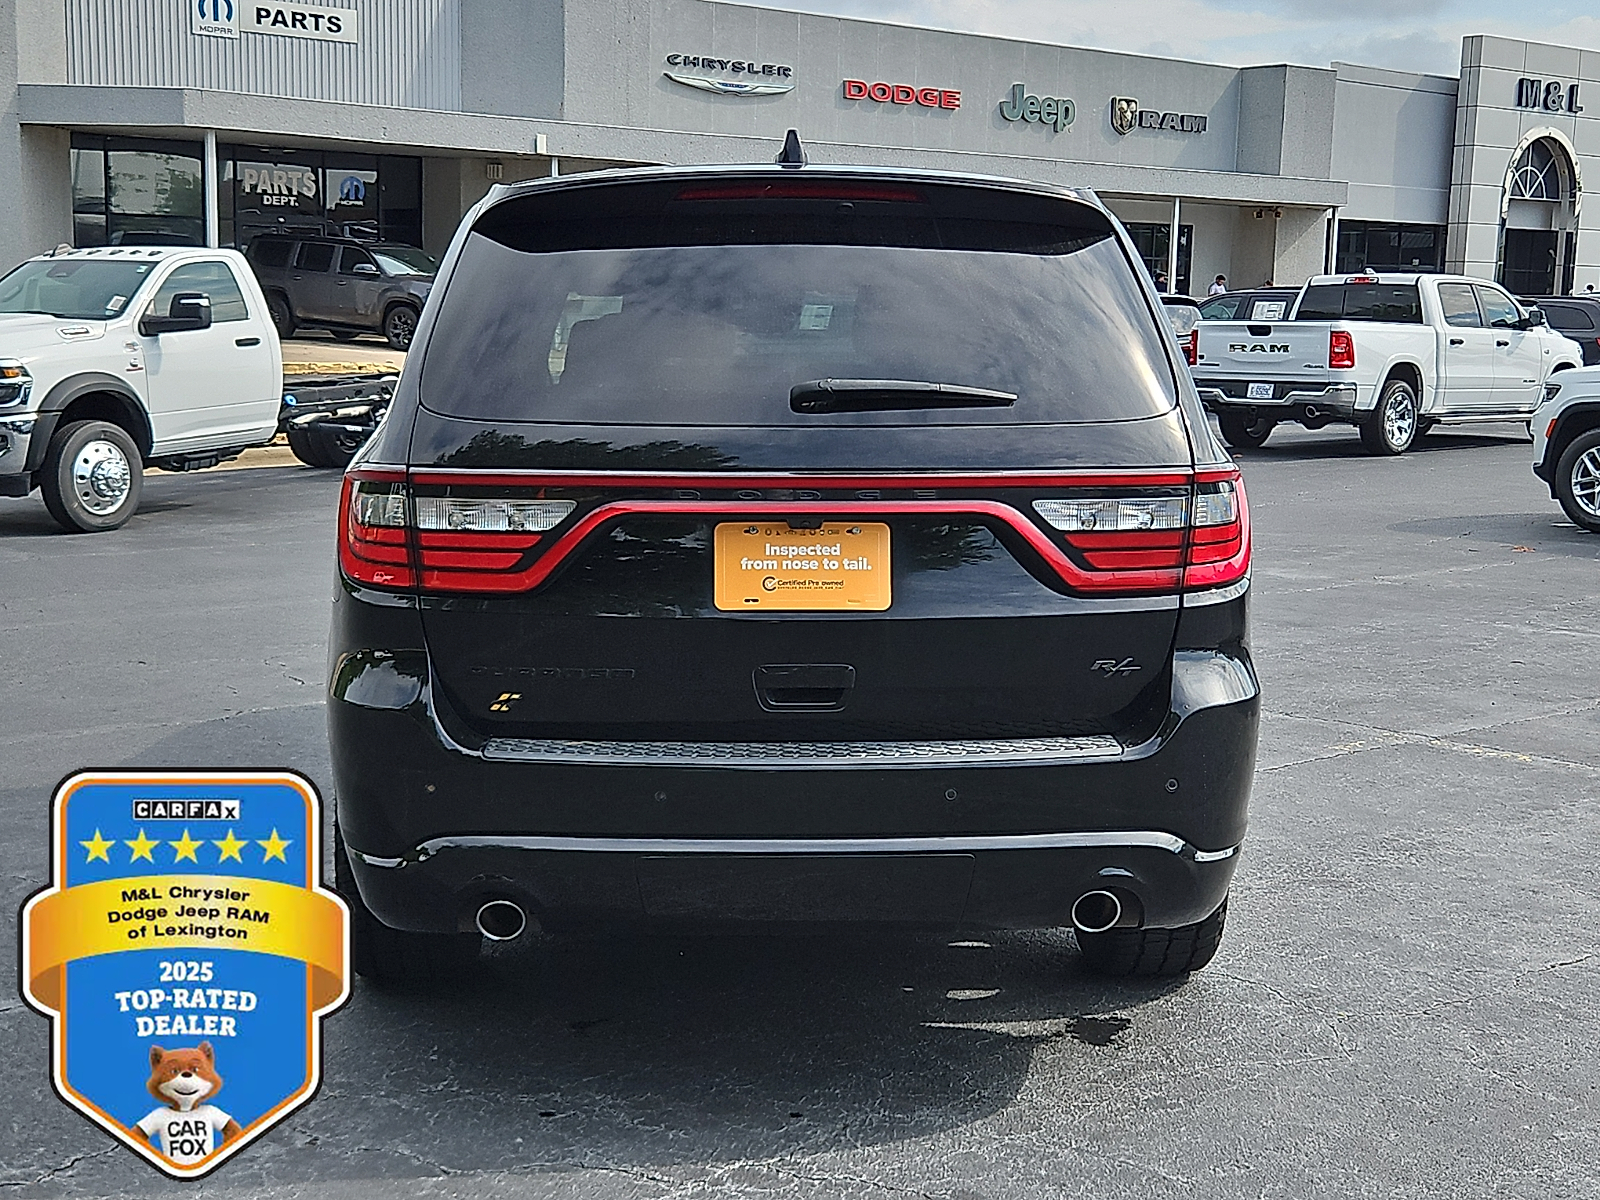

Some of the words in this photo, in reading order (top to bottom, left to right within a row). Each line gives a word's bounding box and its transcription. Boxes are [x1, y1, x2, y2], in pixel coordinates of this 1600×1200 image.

[198, 25, 234, 36] MOPAR
[255, 6, 343, 34] PARTS
[666, 53, 793, 78] CHRYSLER
[842, 78, 962, 109] DODGE
[1516, 77, 1584, 115] M&L
[999, 83, 1076, 133] Jeep
[1138, 109, 1208, 133] RAM
[244, 168, 317, 199] PARTS
[263, 195, 299, 207] DEPT.
[1229, 343, 1290, 353] RAM
[675, 489, 937, 500] DODGE
[765, 543, 841, 558] Inspected
[740, 557, 778, 571] from
[782, 559, 819, 570] nose
[822, 558, 839, 570] to
[842, 557, 872, 571] tail.
[1090, 657, 1142, 678] R/T
